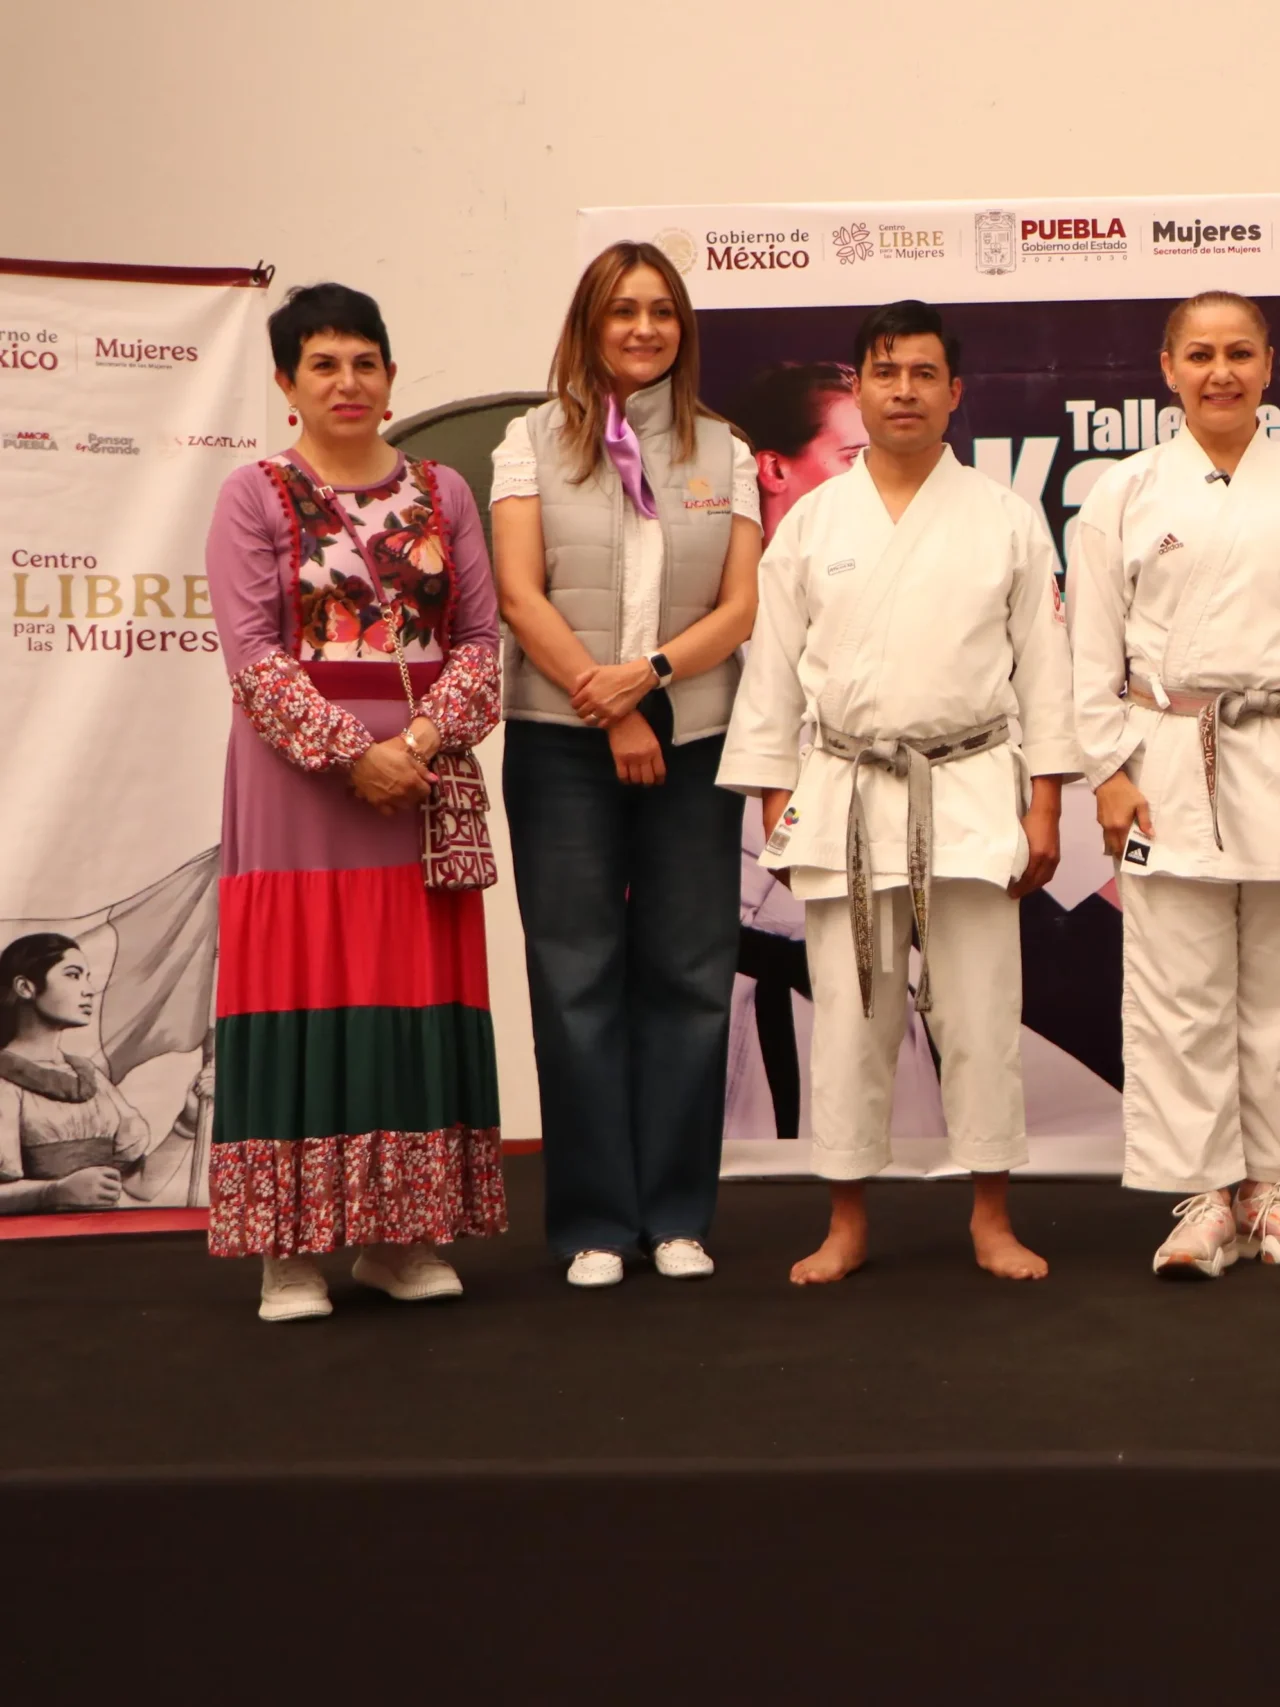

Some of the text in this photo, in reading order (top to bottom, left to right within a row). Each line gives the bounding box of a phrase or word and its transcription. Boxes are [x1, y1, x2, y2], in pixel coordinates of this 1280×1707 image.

[706, 229, 810, 244] Gobierno de
[1021, 218, 1127, 240] PUEBLA
[1153, 219, 1262, 248] Mujeres
[879, 230, 945, 248] LIBRE
[1021, 240, 1128, 252] Gobierno del Estado
[706, 245, 810, 271] México
[895, 247, 945, 260] Mujeres
[1200, 246, 1211, 254] de
[1213, 246, 1226, 254] las
[1227, 245, 1262, 255] Mujeres
[36, 329, 58, 343] de
[0, 342, 59, 370] xico
[95, 337, 199, 362] Mujeres
[1065, 399, 1185, 451] Talle
[3, 438, 59, 451] PUEBLA
[88, 433, 135, 446] Pensar
[11, 549, 98, 569] Centro
[13, 572, 216, 619] LIBRE
[13, 620, 220, 658] para Mujeres
[27, 637, 54, 651] las
